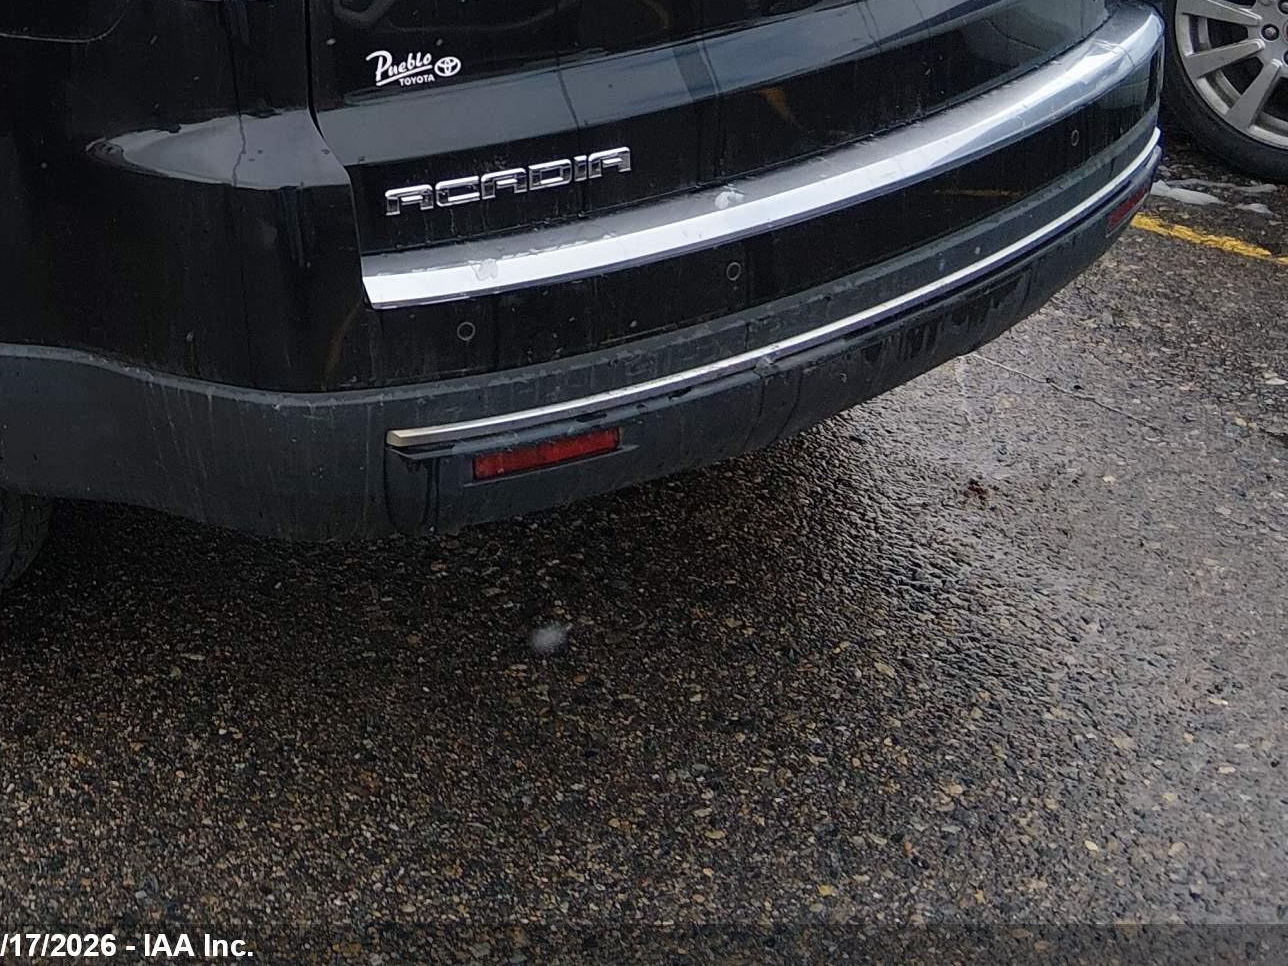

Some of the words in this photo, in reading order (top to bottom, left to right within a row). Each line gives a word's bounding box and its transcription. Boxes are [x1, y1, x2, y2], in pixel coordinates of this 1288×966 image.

[365, 50, 433, 84] Pueblo
[398, 74, 436, 87] TOYOTA
[385, 146, 632, 216] ACADIA
